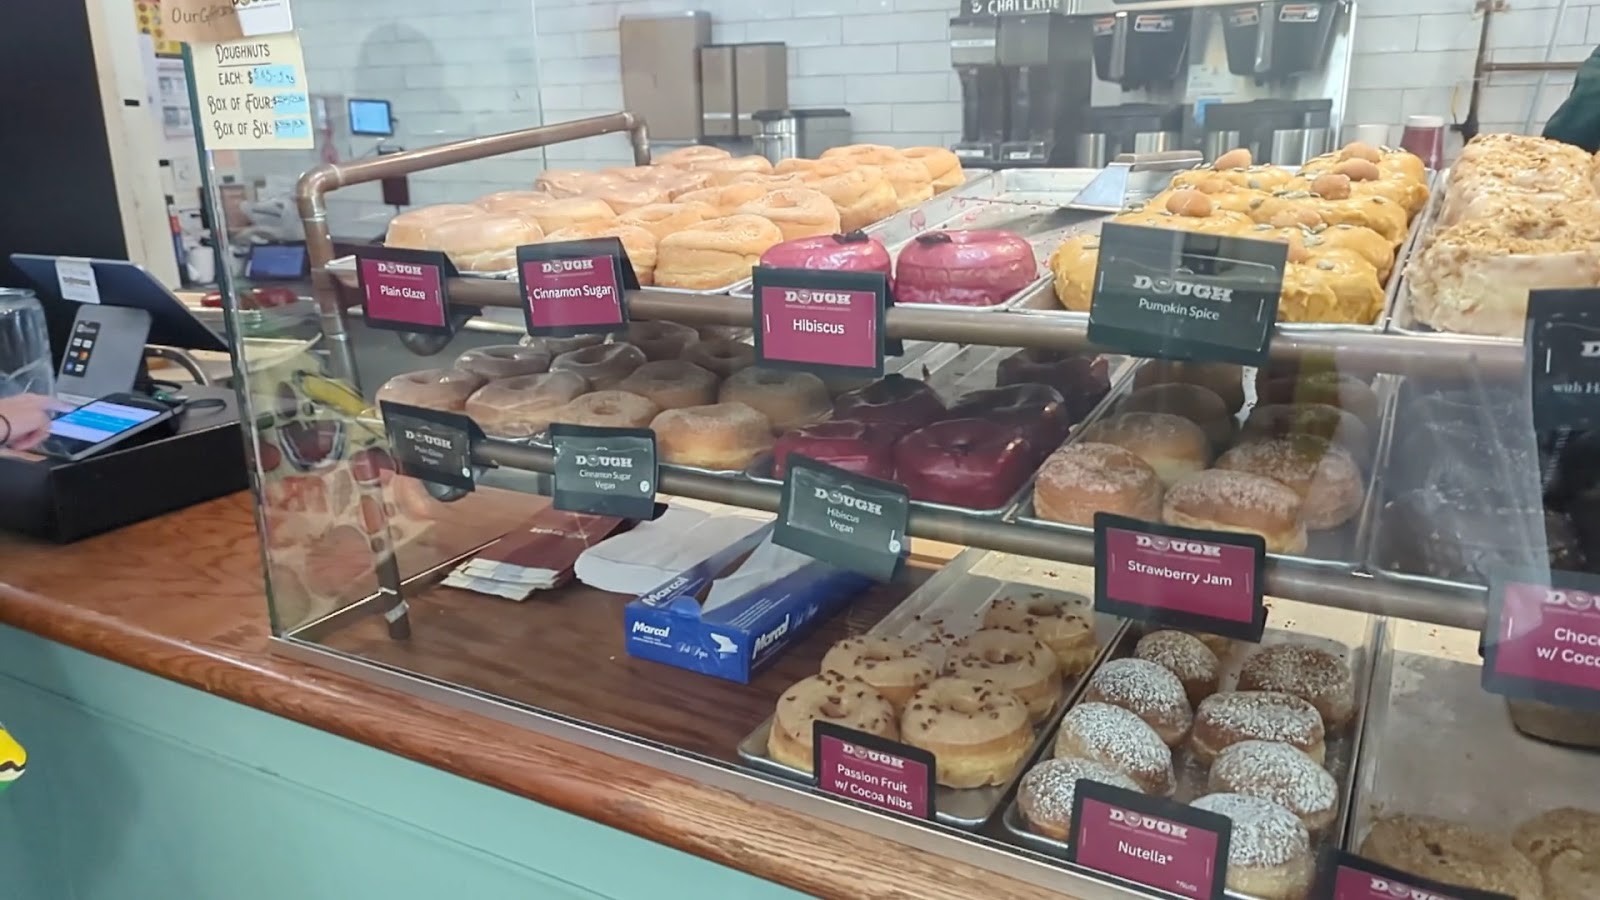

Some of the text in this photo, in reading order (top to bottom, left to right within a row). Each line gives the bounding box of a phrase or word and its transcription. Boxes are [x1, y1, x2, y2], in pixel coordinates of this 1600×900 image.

[215, 44, 271, 64] DOUGHNUTS
[218, 72, 244, 86] EACH:
[377, 262, 422, 276] DOUGH
[542, 259, 594, 273] DOUGH
[380, 285, 426, 300] Plain Glaze
[533, 284, 612, 300] Cinnamon Sugar
[785, 288, 852, 305] DOUGH
[1132, 274, 1234, 303] DOUGH
[1138, 297, 1220, 321] Pumpkin Spice
[793, 318, 845, 335] Hibiscus
[404, 430, 453, 450] DOUGH
[575, 454, 633, 468] DOUGH
[579, 469, 632, 482] Cinnamon Sugar
[595, 481, 616, 491] Vegan
[814, 487, 883, 516] DOUGH
[826, 507, 860, 524] Hibiscus
[829, 519, 854, 534] Vegan
[1135, 535, 1221, 558] DOUGH
[1127, 560, 1233, 587] Strawberry Jam
[642, 576, 690, 606] Marcal
[632, 621, 670, 638] Marcal
[751, 613, 790, 661] Marcal
[1554, 627, 1600, 647] Choc
[1536, 646, 1559, 661] w/
[842, 742, 905, 769] DOUGH
[837, 763, 909, 794] Passion Fruit
[834, 779, 913, 811] w/ Cocoa Nibs
[1108, 808, 1189, 840] DOUGH
